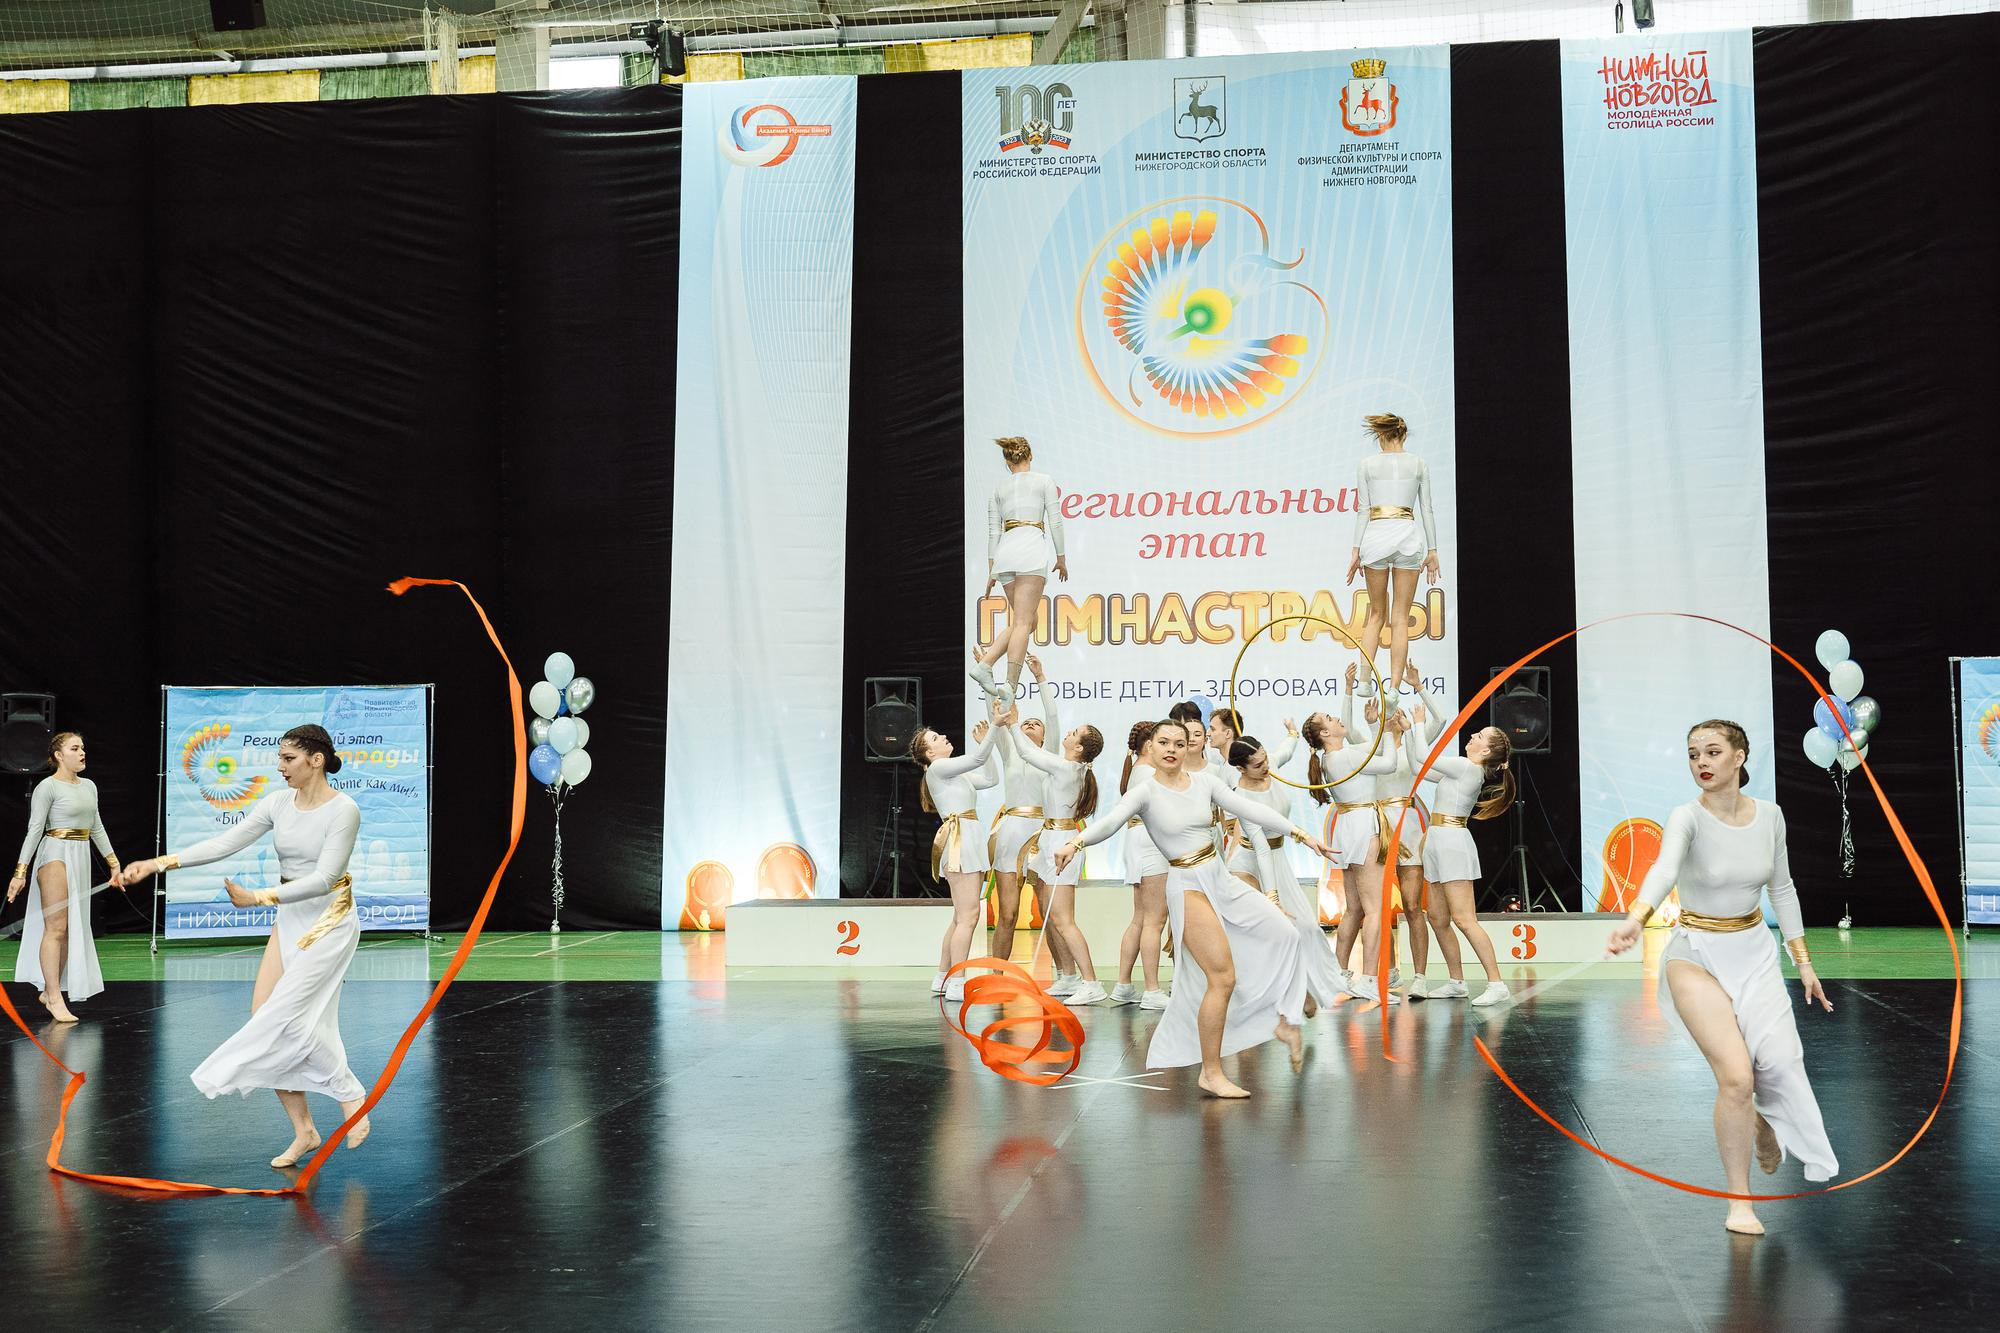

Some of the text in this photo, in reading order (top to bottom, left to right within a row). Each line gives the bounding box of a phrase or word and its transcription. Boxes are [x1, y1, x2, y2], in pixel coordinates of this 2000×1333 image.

[1057, 99, 1078, 109] ЛЕТ
[1607, 108, 1692, 120] МОЛОДЁЖНАЯ
[1607, 117, 1715, 130] СТОЛИЦА РОССИИ
[1135, 147, 1266, 161] МИНИСТЕРСТВО СПОРТА
[1340, 142, 1399, 153] ДЕПАРТАМЕНТ
[979, 155, 1097, 168] МИНИСТЕРСТВО СПОРТА
[1134, 158, 1267, 171] НИЖЕГОРОДСКОЙ ОБЛАСТИ
[1297, 151, 1442, 166] ФИЗИЧЕСКОЙ КУЛЬТУРЫ И СПОРТА
[973, 165, 1101, 179] РОССИЙСКОЙ ФЕДЕРАЦИИ
[1331, 164, 1408, 176] АДМИНИСТРАЦИИ
[1323, 175, 1417, 187] НИЖНЕГО НОВГОРОДА
[1056, 486, 1358, 519] егиональны
[1138, 530, 1267, 560] этап
[1119, 680, 1184, 702] ДЕТИ
[1205, 678, 1337, 701] ЗДОРОВАЯ
[348, 734, 383, 745] этап
[366, 779, 387, 790] как
[836, 920, 860, 956] 2
[1511, 923, 1537, 960] 3
